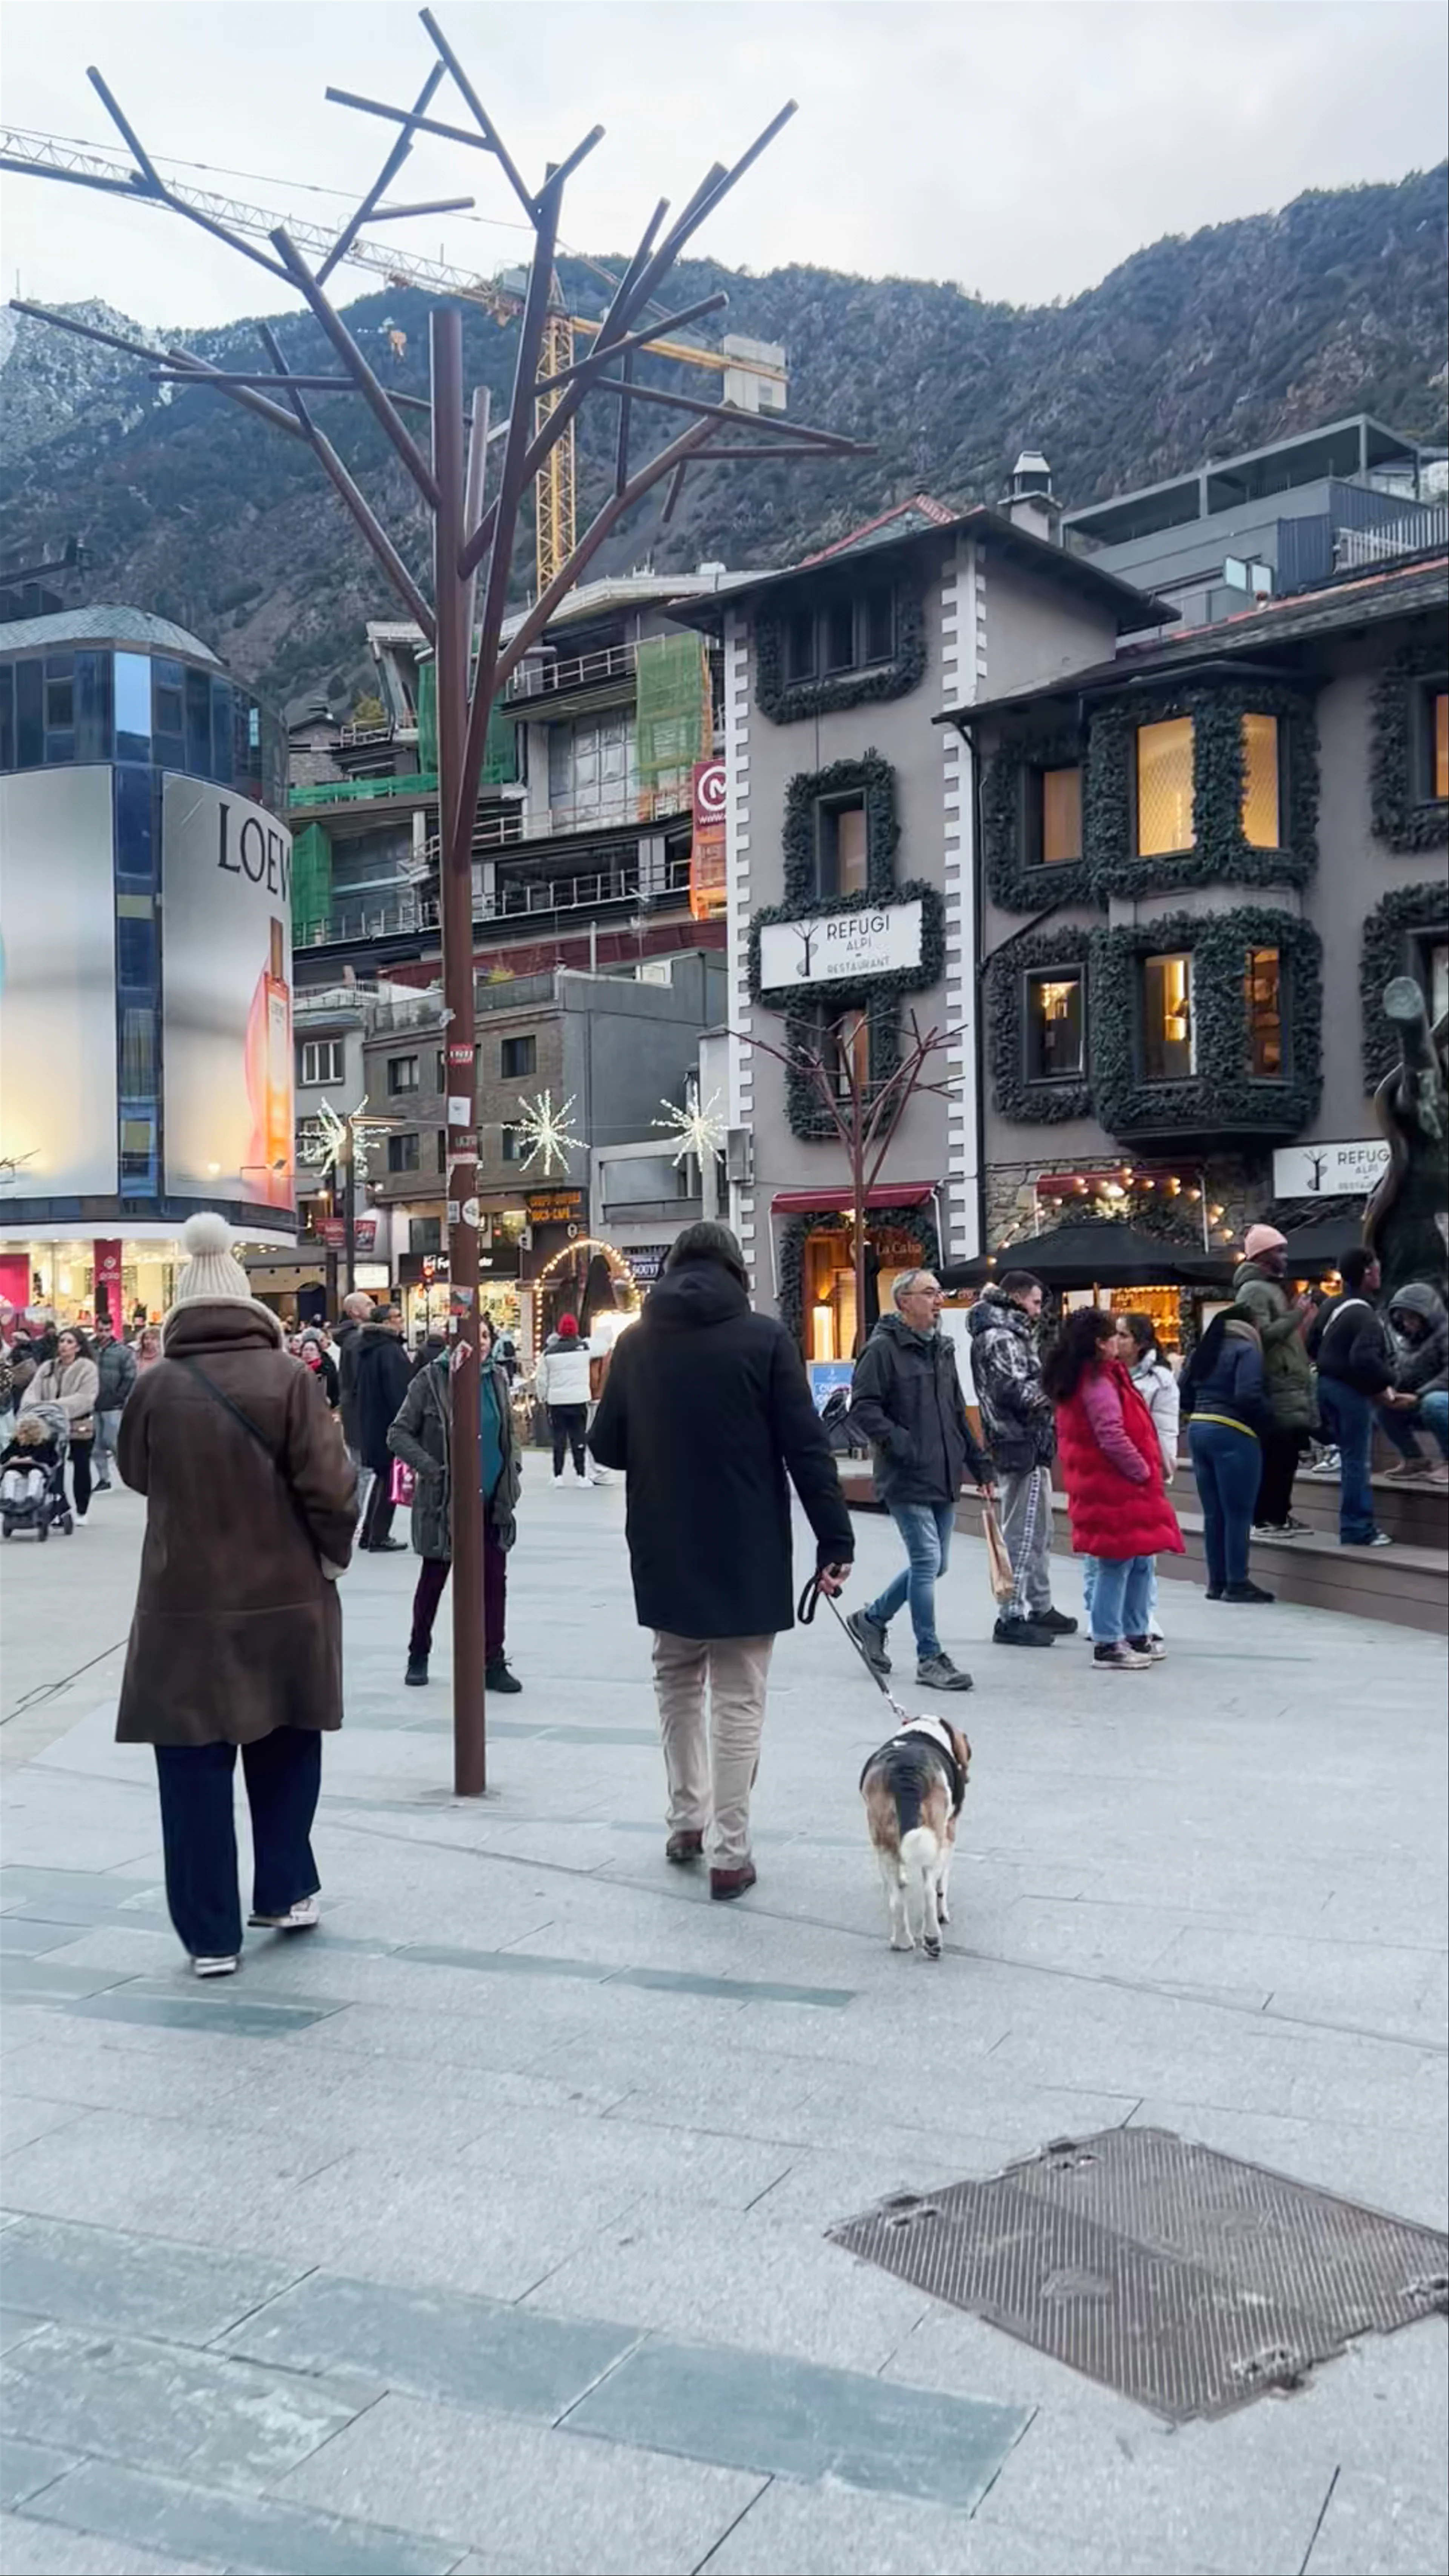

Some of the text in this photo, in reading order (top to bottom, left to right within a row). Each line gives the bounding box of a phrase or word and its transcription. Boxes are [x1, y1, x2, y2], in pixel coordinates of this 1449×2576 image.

[827, 914, 889, 940] REFUGI
[827, 956, 890, 973] RESTAURANT
[1338, 1148, 1390, 1165] REFUG
